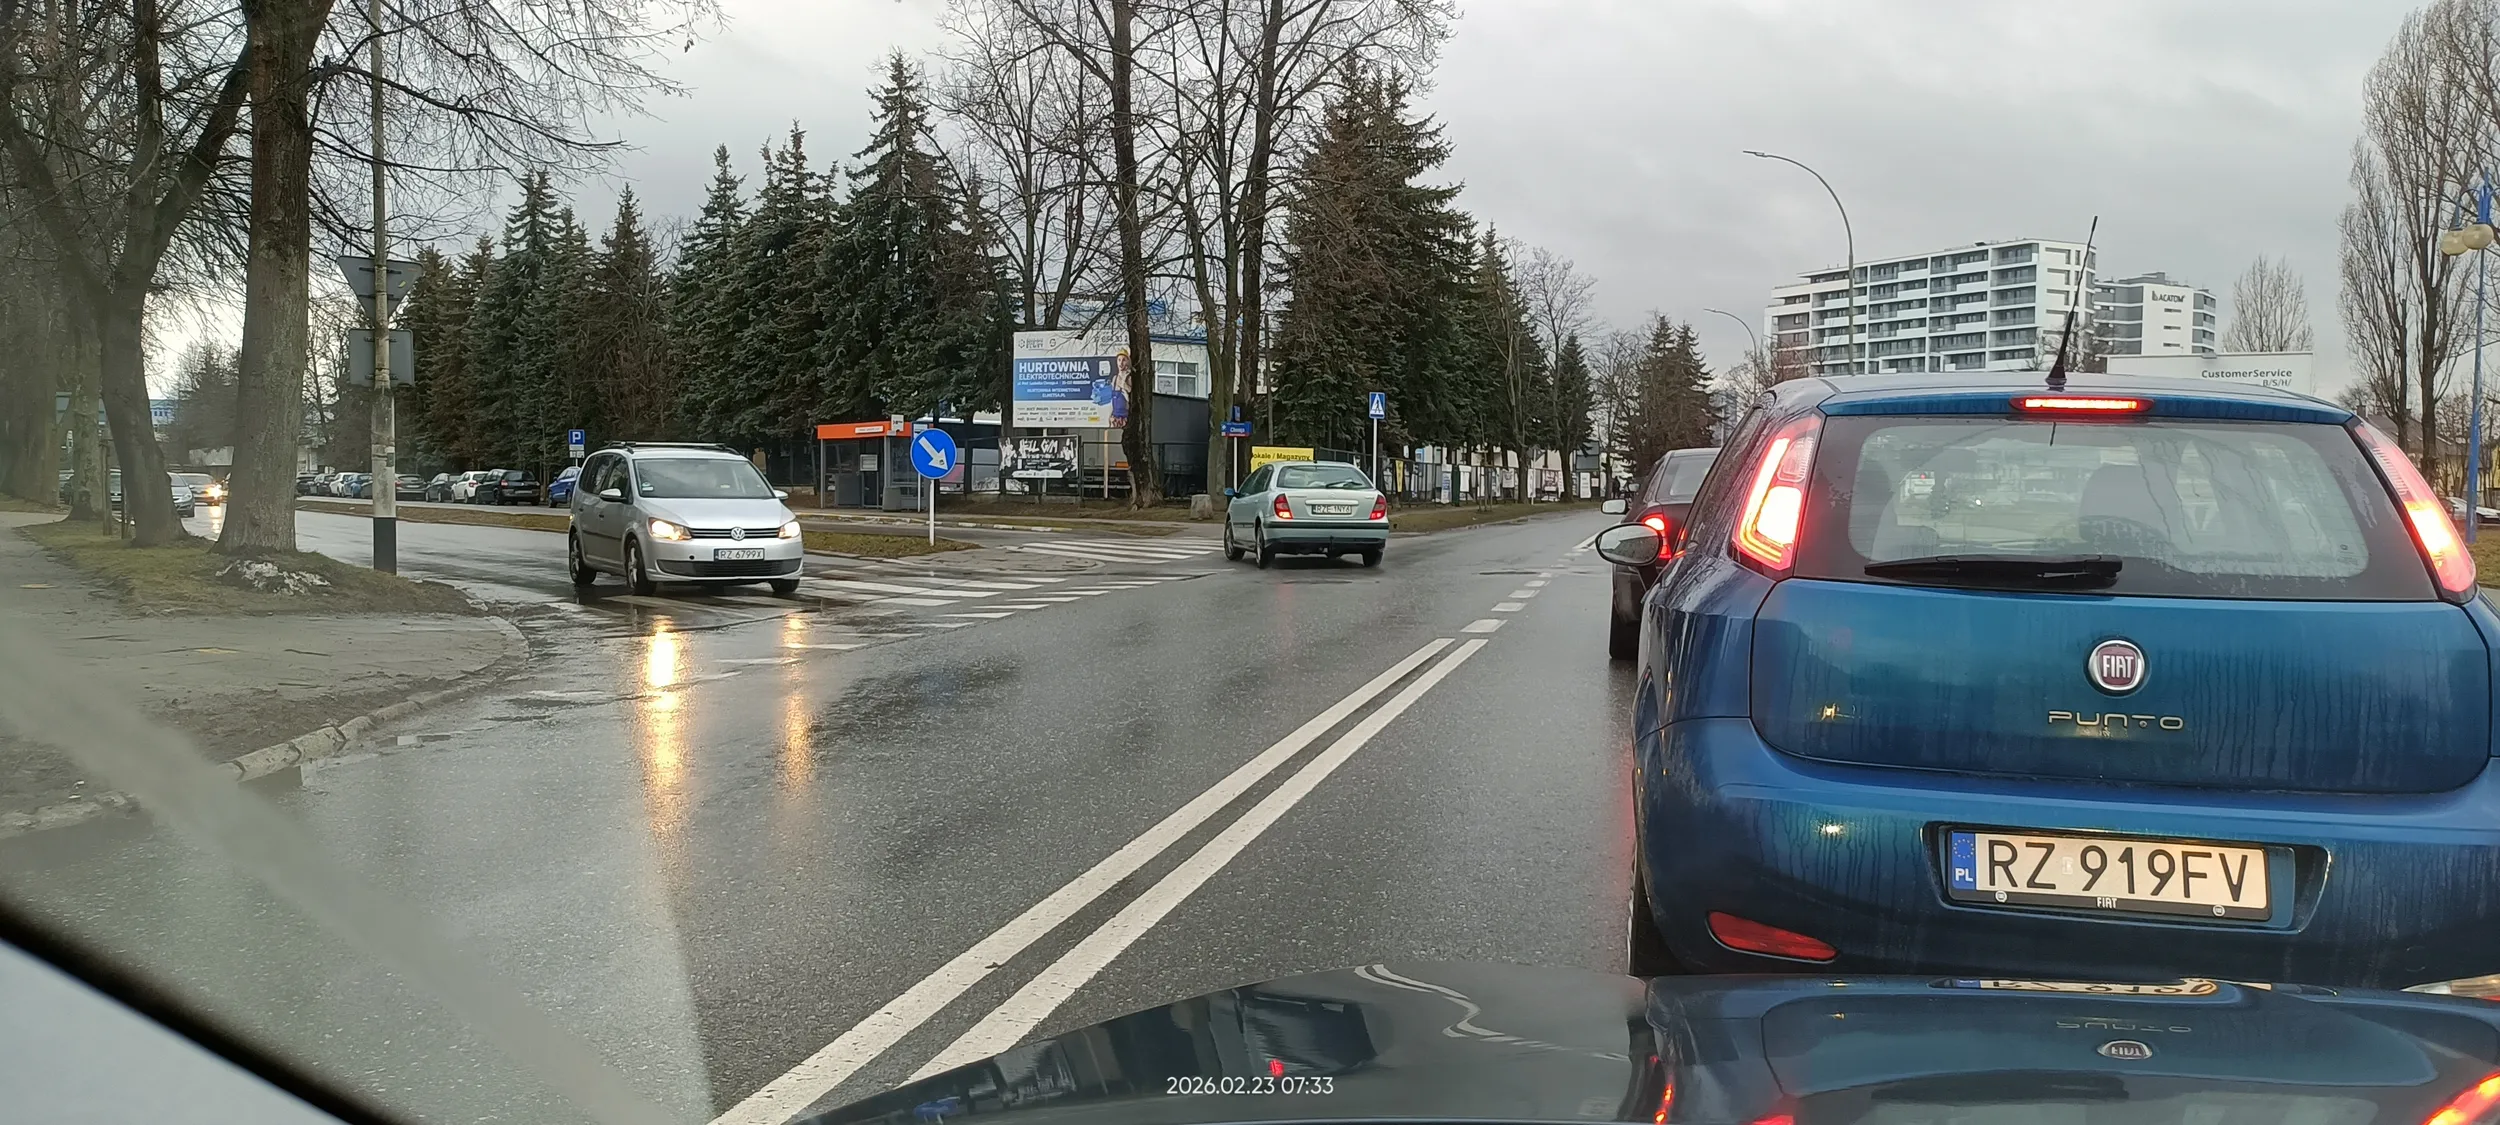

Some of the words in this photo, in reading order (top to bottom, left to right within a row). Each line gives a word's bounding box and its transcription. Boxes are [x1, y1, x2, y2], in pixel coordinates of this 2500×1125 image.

[1019, 361, 1090, 373] HURTOWNIA
[1018, 372, 1090, 381] ELEKTROTECHNICZNA
[2201, 368, 2292, 379] CustomerService
[572, 431, 582, 443] P
[720, 550, 733, 559] RZ
[2102, 655, 2134, 678] FIAT
[2048, 710, 2184, 730] PUNTO
[1955, 868, 1974, 882] PL
[1988, 839, 2057, 889] RZ
[2079, 845, 2249, 902] 919FV
[2096, 896, 2118, 909] FIAT
